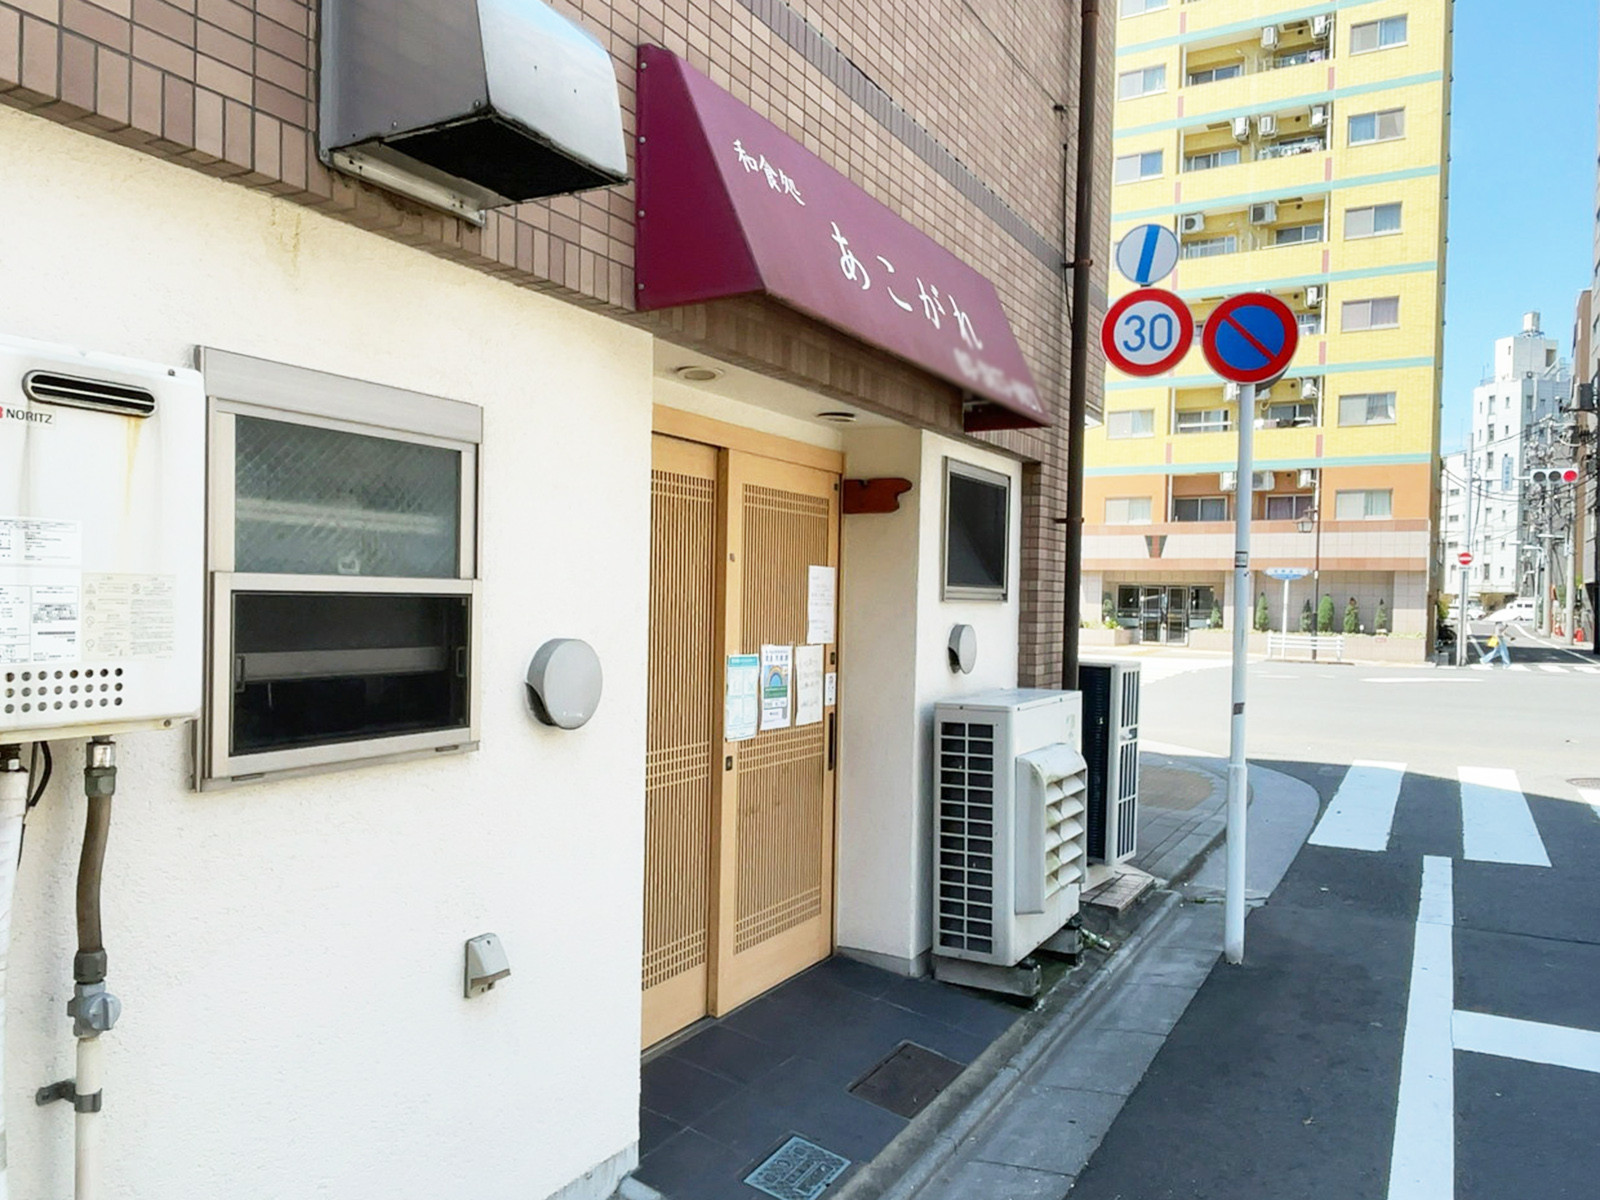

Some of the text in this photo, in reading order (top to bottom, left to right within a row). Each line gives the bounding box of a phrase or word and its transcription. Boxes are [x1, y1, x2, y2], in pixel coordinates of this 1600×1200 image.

[733, 139, 806, 206] 和食処
[831, 221, 983, 350] あこがれ
[1123, 313, 1173, 353] 30
[6, 408, 52, 424] NORITZ
